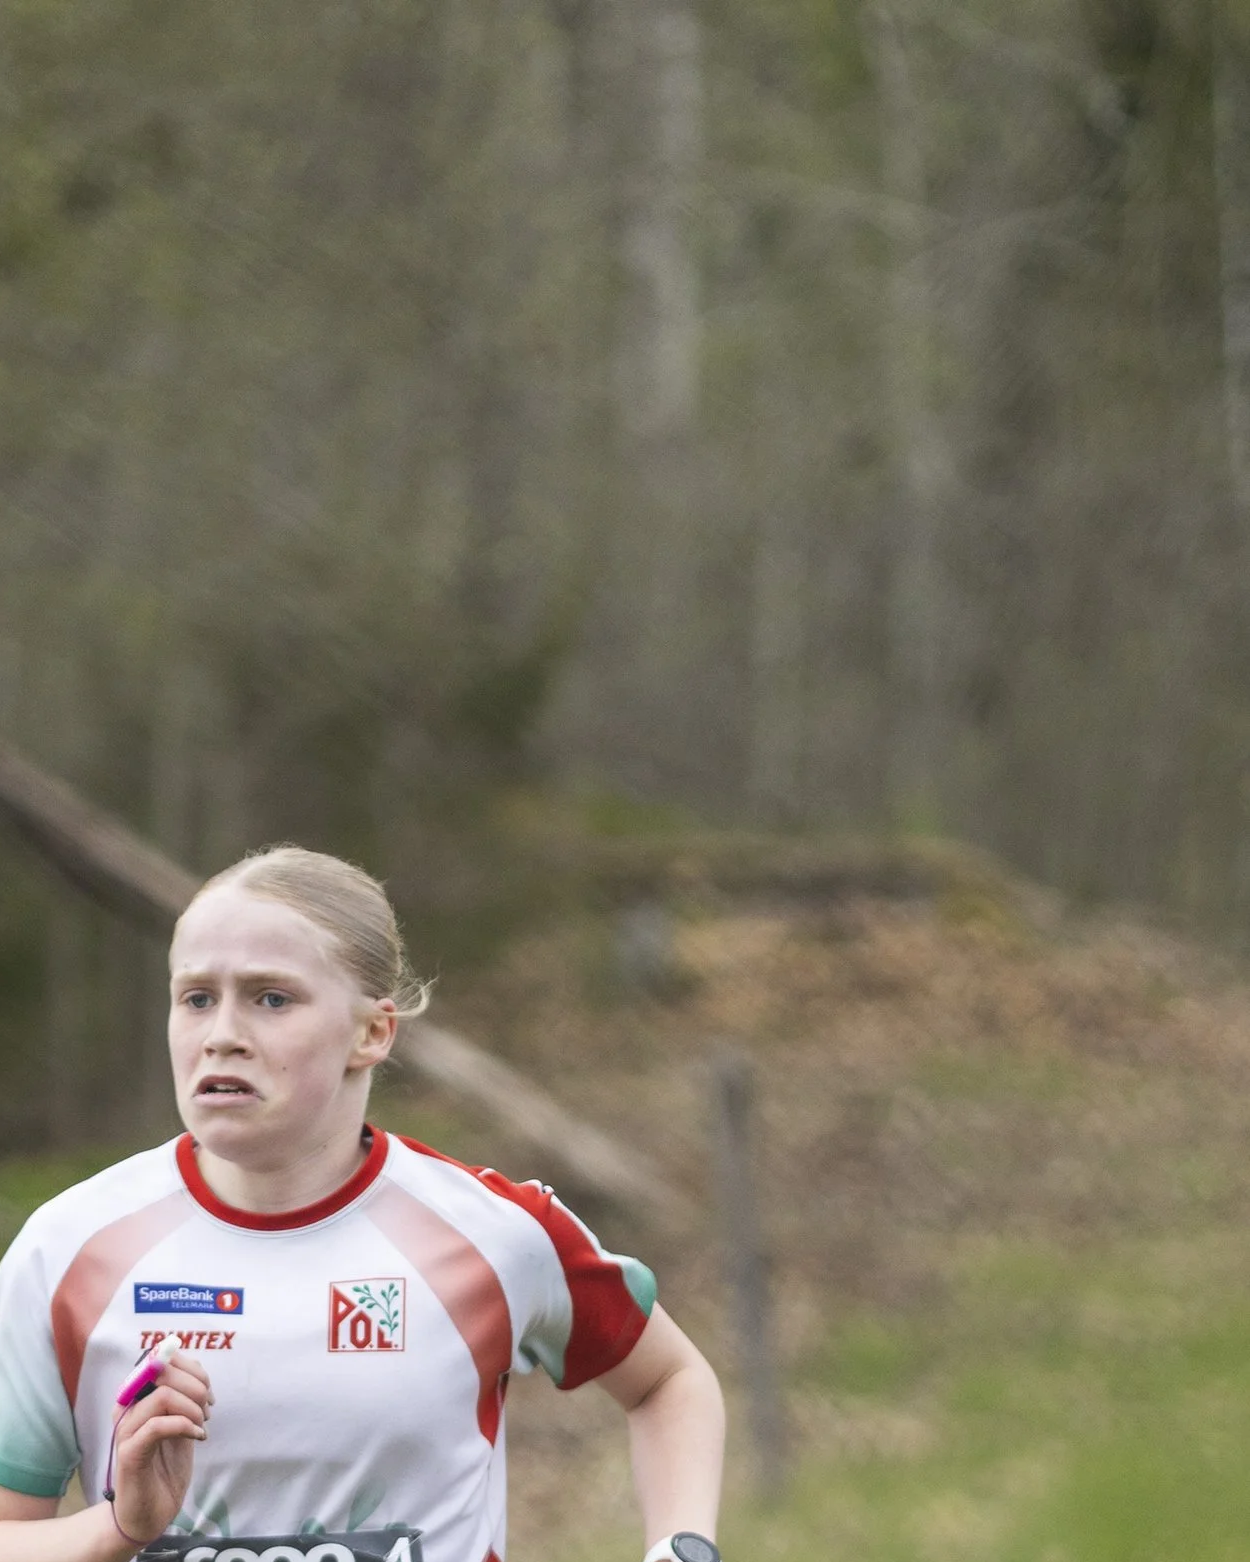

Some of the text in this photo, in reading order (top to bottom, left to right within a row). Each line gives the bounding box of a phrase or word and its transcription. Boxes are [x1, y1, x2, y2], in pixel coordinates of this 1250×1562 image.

[139, 1286, 214, 1305] SpareBank
[171, 1301, 214, 1309] TELEMARK
[140, 1330, 236, 1350] TRMTEX
